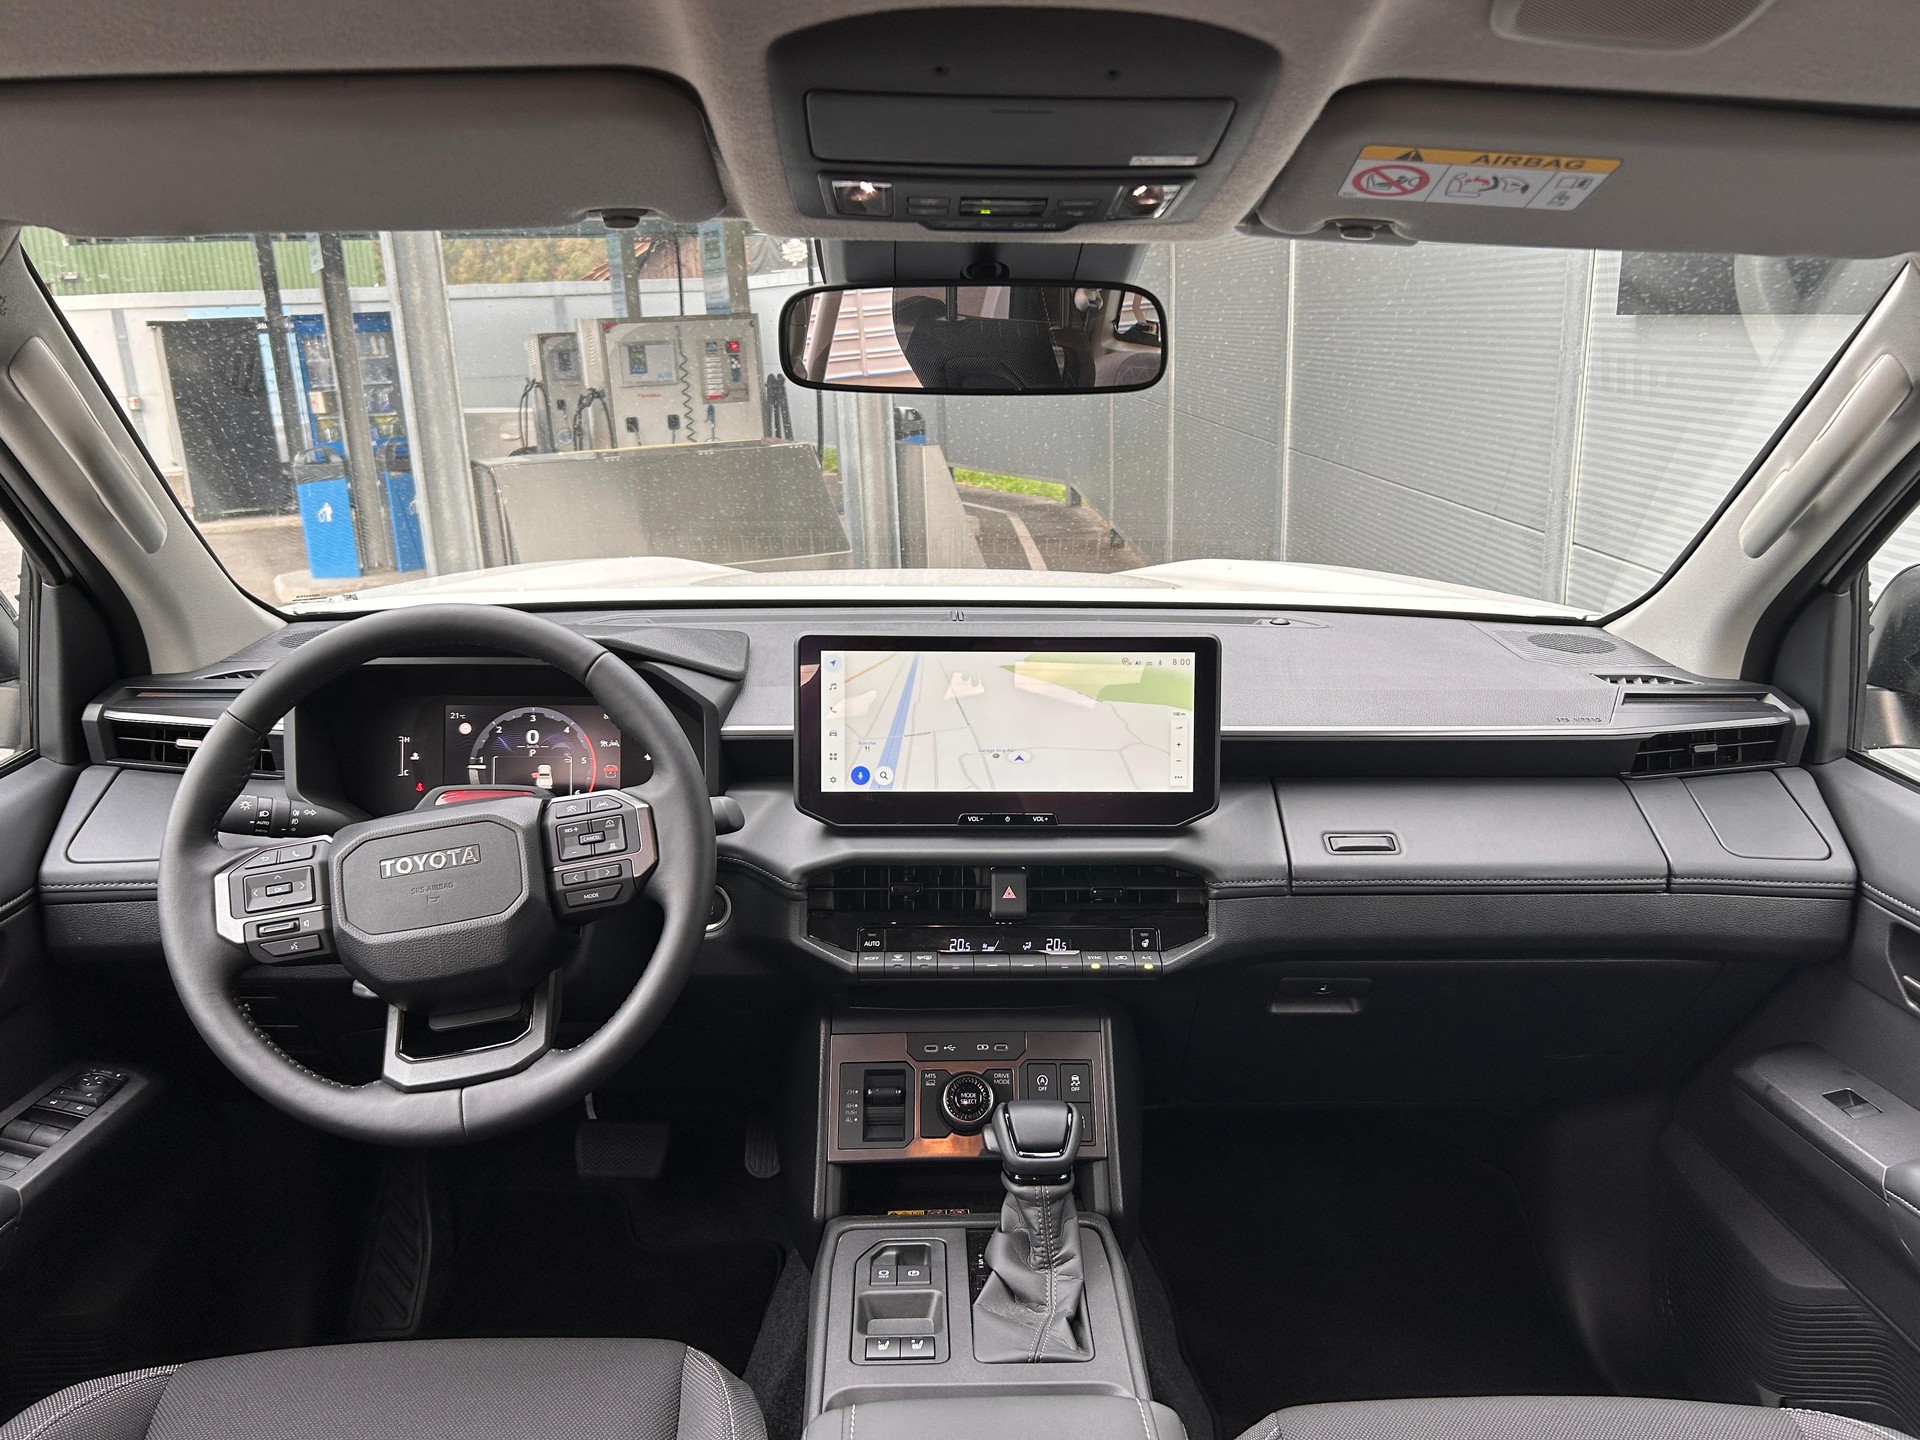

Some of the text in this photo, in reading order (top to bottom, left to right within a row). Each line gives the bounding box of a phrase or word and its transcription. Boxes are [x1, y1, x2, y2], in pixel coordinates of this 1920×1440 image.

[1470, 154, 1586, 171] AIRBAG
[1172, 658, 1191, 666] 8:00
[496, 726, 502, 734] 2
[526, 729, 540, 744] 0
[529, 749, 536, 757] P
[381, 847, 479, 877] TOYOTA
[411, 882, 454, 895] SRS AIRBAG
